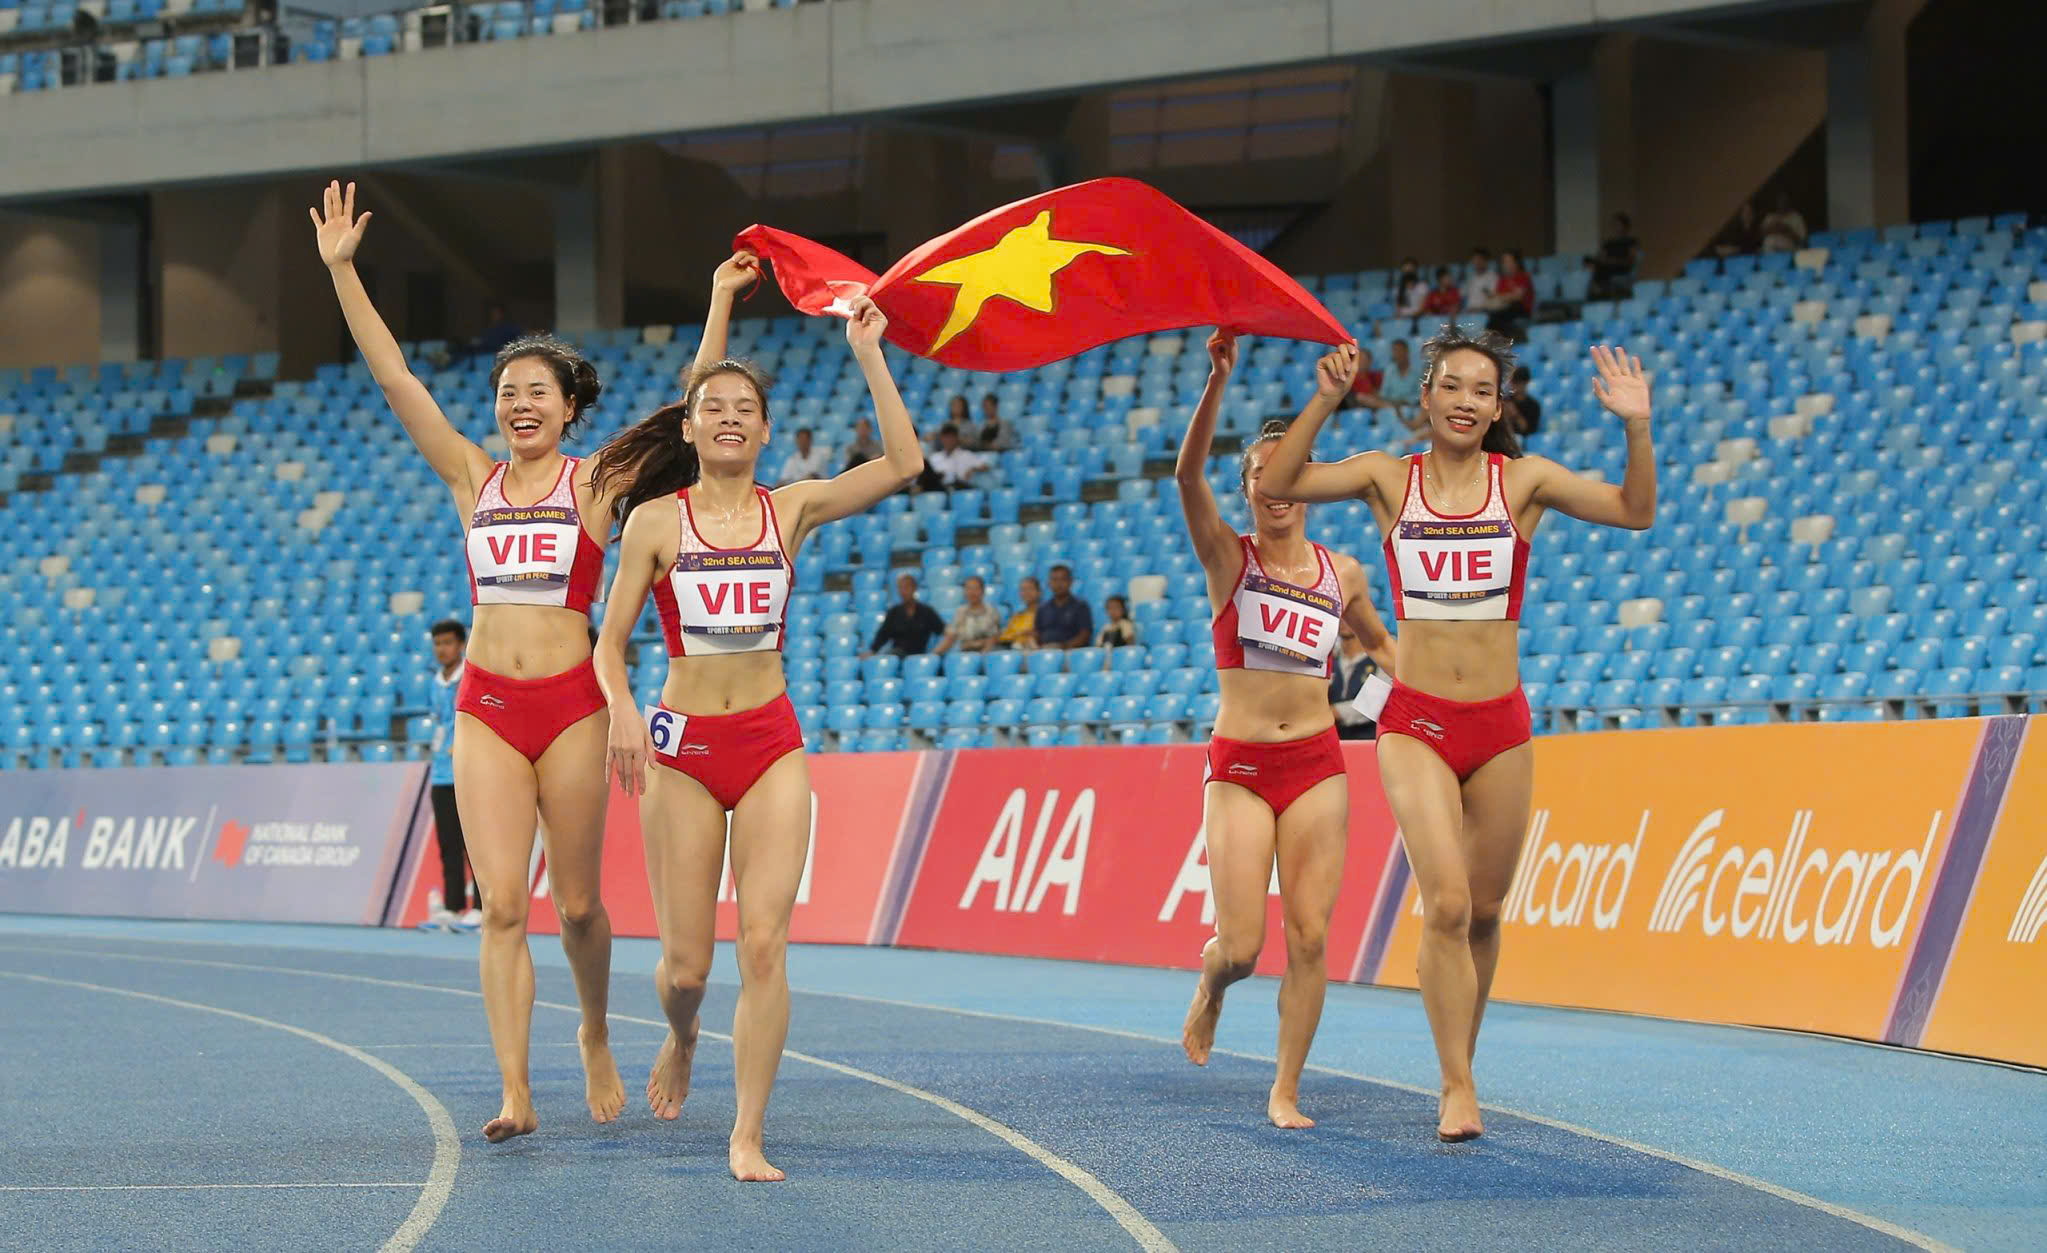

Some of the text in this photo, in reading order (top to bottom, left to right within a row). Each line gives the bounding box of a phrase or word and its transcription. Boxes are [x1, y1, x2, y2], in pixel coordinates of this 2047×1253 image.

[492, 510, 566, 521] 32nd SEA GAMES
[1423, 525, 1500, 535] 32nd SEA GAMES
[487, 533, 557, 565] VIE
[702, 555, 775, 566] 32nd SEA GAMES
[1418, 550, 1493, 581] VIE
[697, 582, 771, 615] VIE
[1268, 583, 1333, 610] 32nd SEA GAMES
[1260, 602, 1324, 649] VIE
[650, 711, 674, 750] 6
[0, 816, 198, 869] ABA BANK
[959, 787, 1096, 916] AIA
[1703, 809, 1943, 949] cellcard
